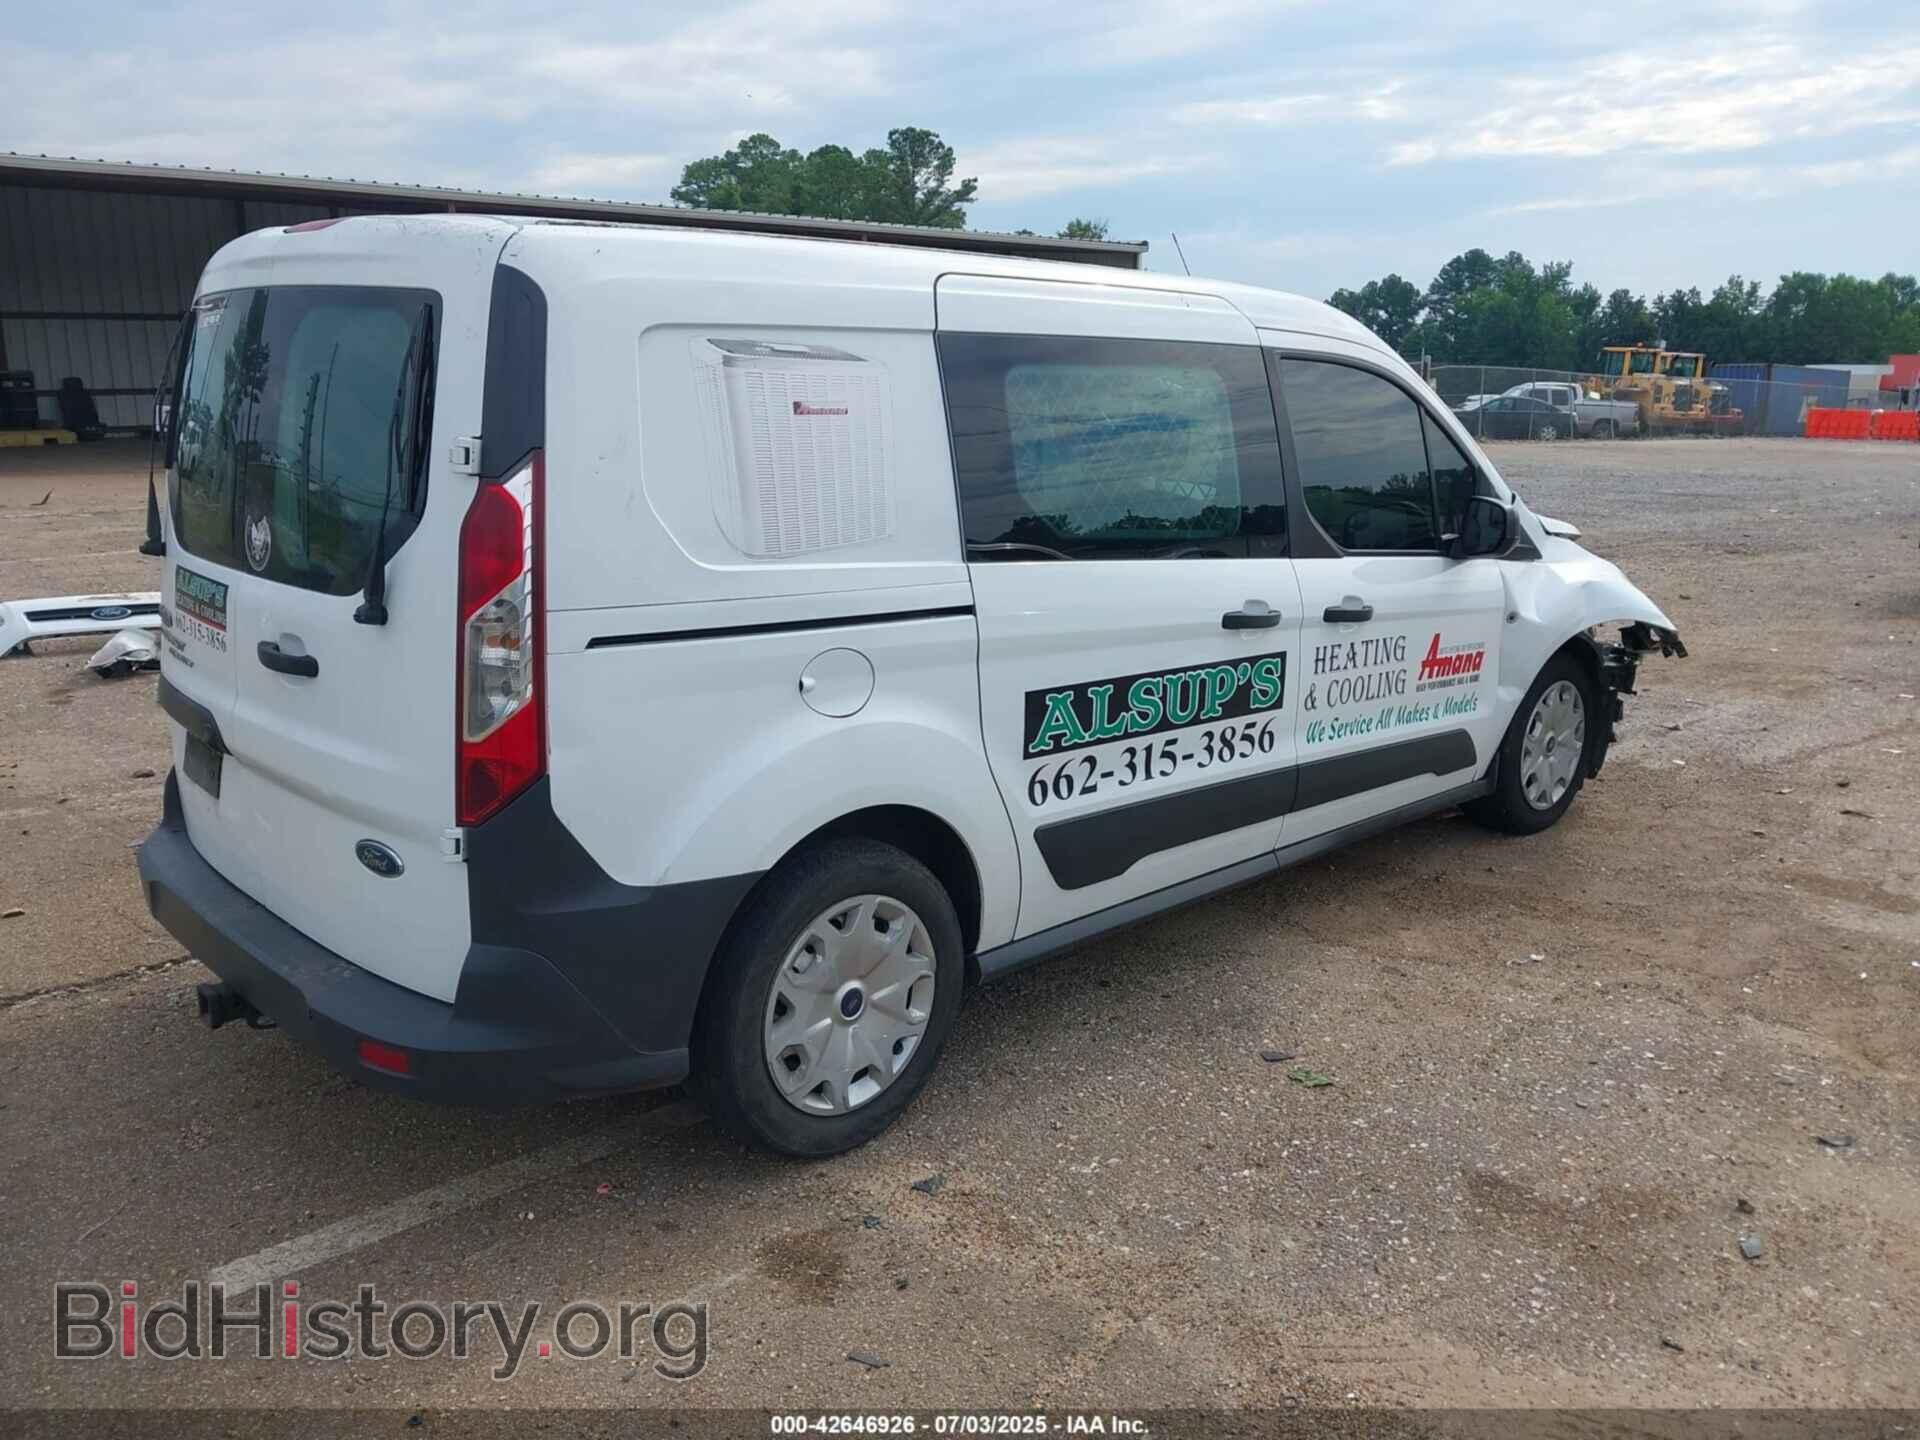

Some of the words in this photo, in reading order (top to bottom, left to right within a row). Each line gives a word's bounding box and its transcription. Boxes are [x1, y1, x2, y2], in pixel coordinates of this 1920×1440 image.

[1313, 635, 1407, 675] HEATING
[1418, 632, 1485, 681] Amana
[1028, 658, 1282, 753] ALSUP'S
[1304, 682, 1318, 711] &
[1327, 668, 1408, 708] COOLING
[1306, 719, 1326, 744] We
[1328, 714, 1373, 741] Service
[1375, 706, 1394, 731] All
[1394, 702, 1431, 728] Makes
[1432, 708, 1440, 720] &
[1442, 691, 1479, 718] Models
[1027, 716, 1278, 807] 662-315-3856
